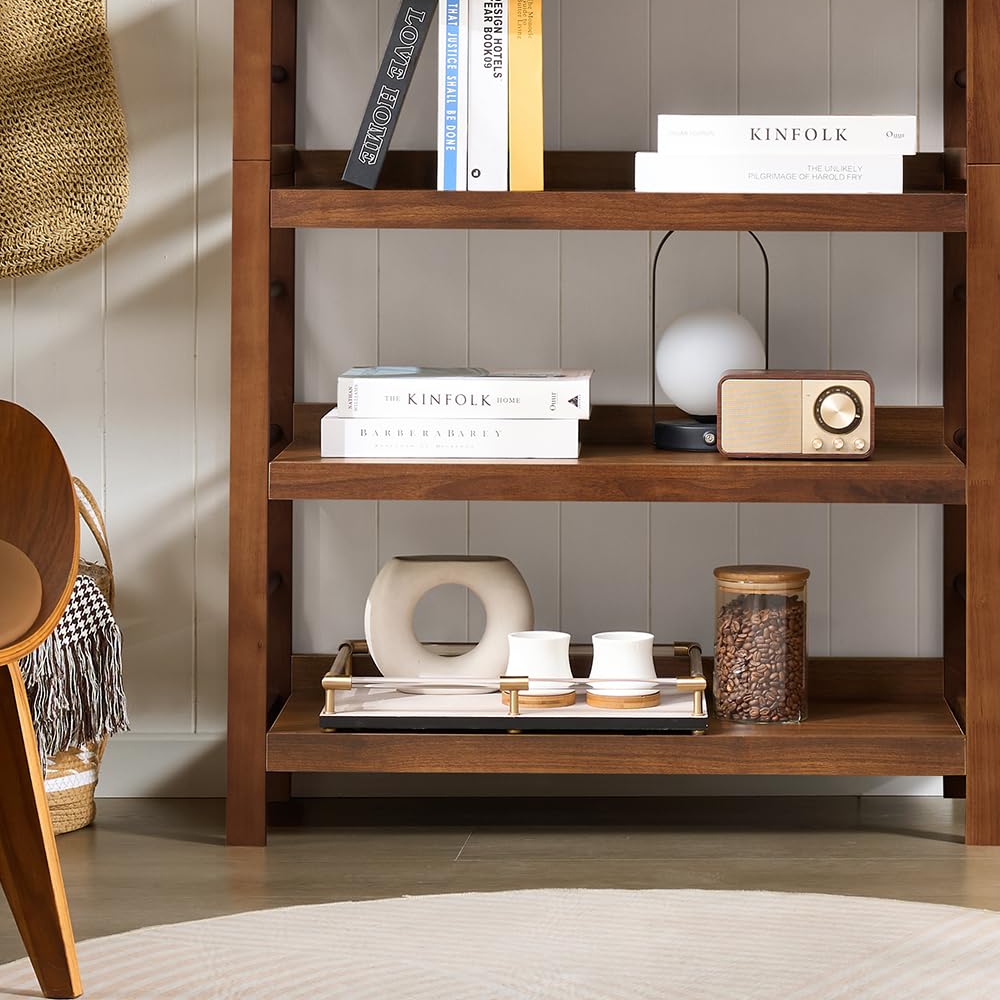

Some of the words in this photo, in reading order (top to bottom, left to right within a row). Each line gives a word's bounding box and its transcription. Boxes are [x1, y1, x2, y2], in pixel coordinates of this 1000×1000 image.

[447, 3, 458, 26] THAT
[386, 7, 426, 80] LOVE
[447, 32, 458, 70] JUSTICE
[493, 38, 503, 79] HOTELS
[446, 75, 457, 104] SHALL
[358, 85, 400, 165] HOME
[446, 110, 457, 121] BE
[445, 125, 457, 151] DONE
[750, 127, 848, 142] KINFOLK
[748, 173, 797, 181] PILGRIMAGE
[798, 173, 810, 181] OF
[812, 173, 845, 181] HAROLD
[847, 173, 863, 181] FRY
[407, 393, 491, 406] KINFOLK
